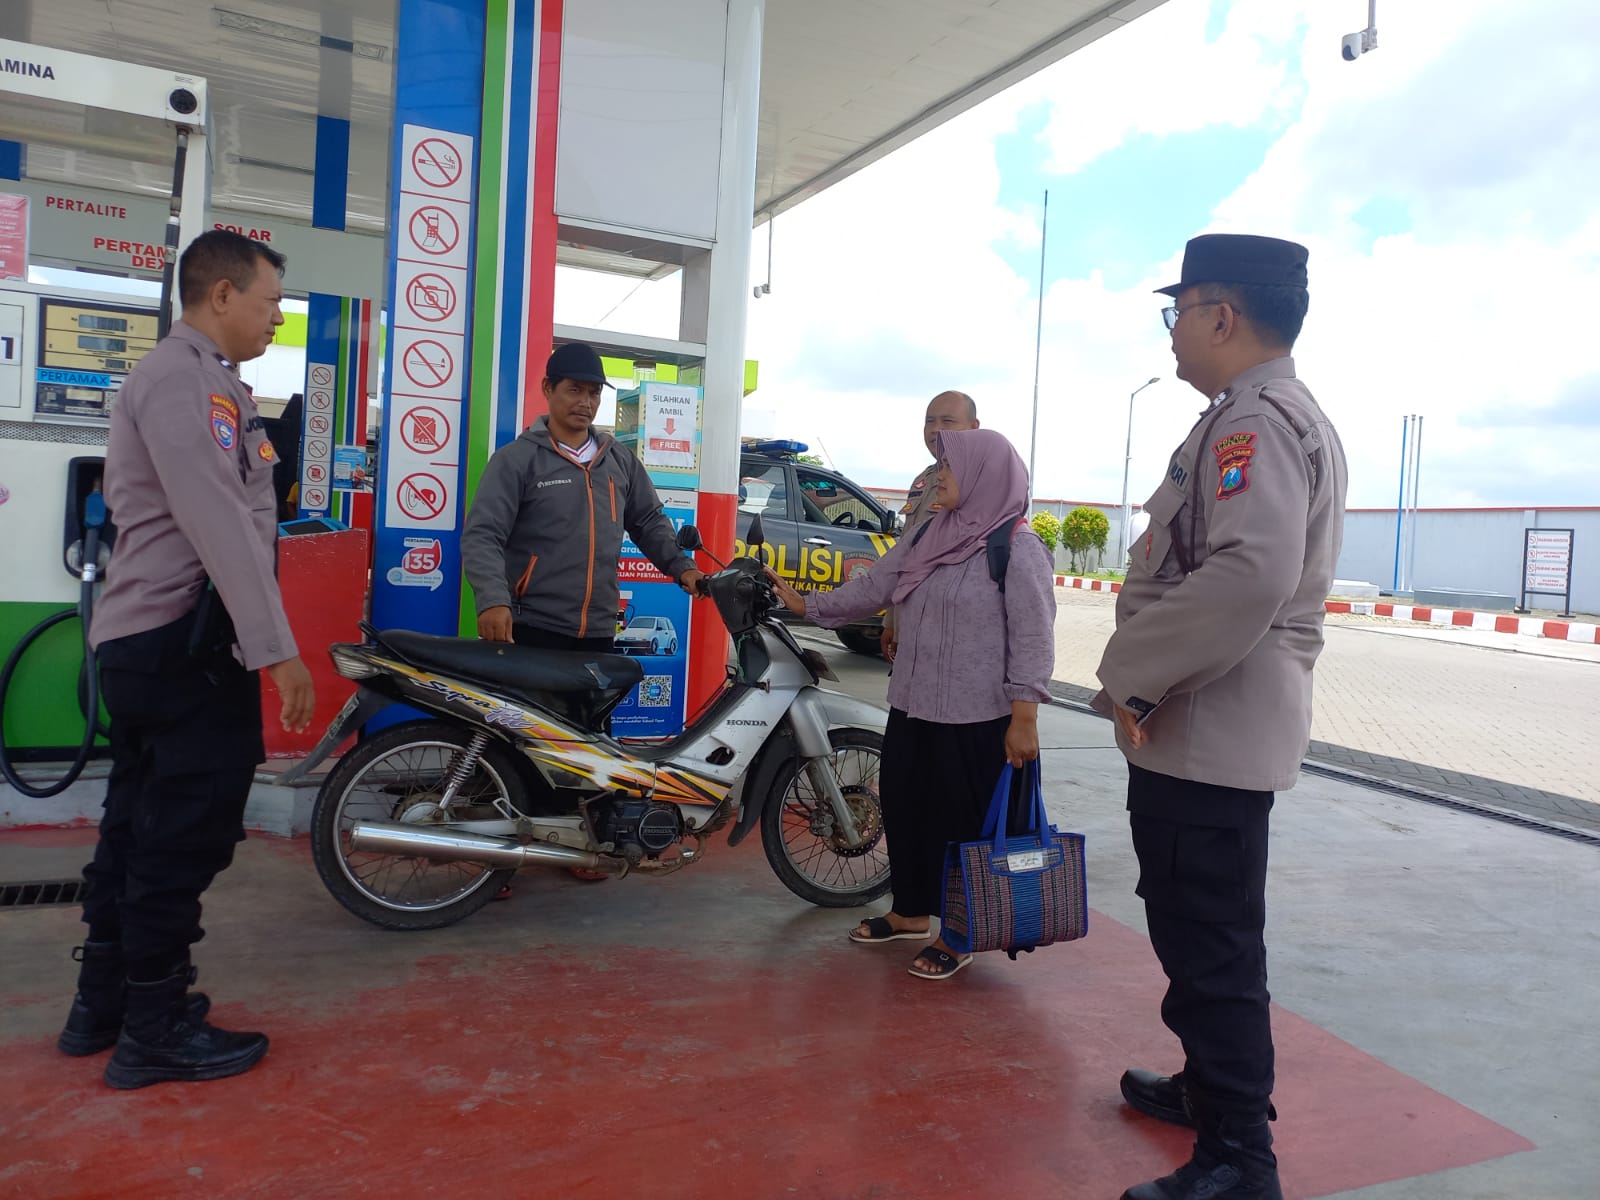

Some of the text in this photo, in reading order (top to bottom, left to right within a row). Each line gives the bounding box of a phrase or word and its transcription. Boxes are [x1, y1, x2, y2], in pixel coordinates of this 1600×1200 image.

[0, 58, 55, 80] MINA
[45, 196, 127, 219] PERTALITE
[93, 237, 167, 258] PERTAM
[1, 336, 14, 359] 1
[40, 370, 109, 385] PERTAMAX
[652, 394, 691, 405] SILAHKAN
[658, 407, 683, 416] AMBIL
[659, 441, 681, 449] FREE
[404, 552, 436, 570] 135
[784, 580, 834, 593] TIKALEN
[726, 719, 768, 727] HONDA
